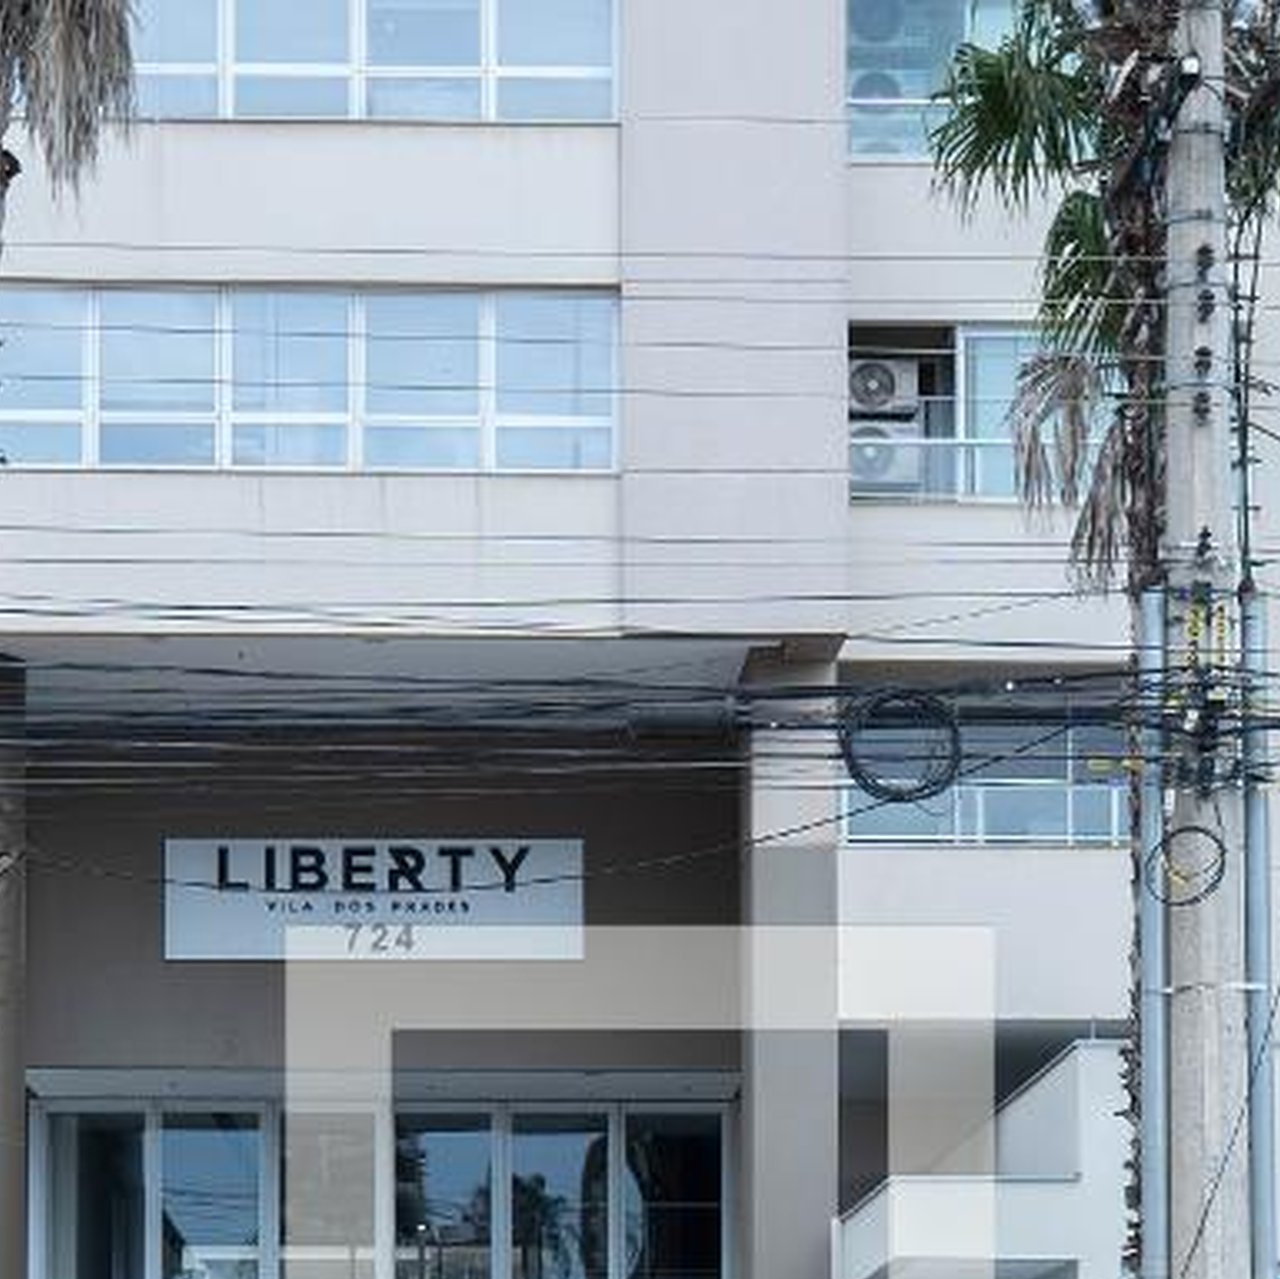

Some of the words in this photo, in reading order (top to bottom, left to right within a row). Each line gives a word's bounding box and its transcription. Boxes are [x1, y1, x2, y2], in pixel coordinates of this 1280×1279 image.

[216, 845, 531, 893] LIBERTY
[265, 900, 314, 914] VILA
[333, 900, 377, 914] DOS
[345, 923, 415, 952] 724
